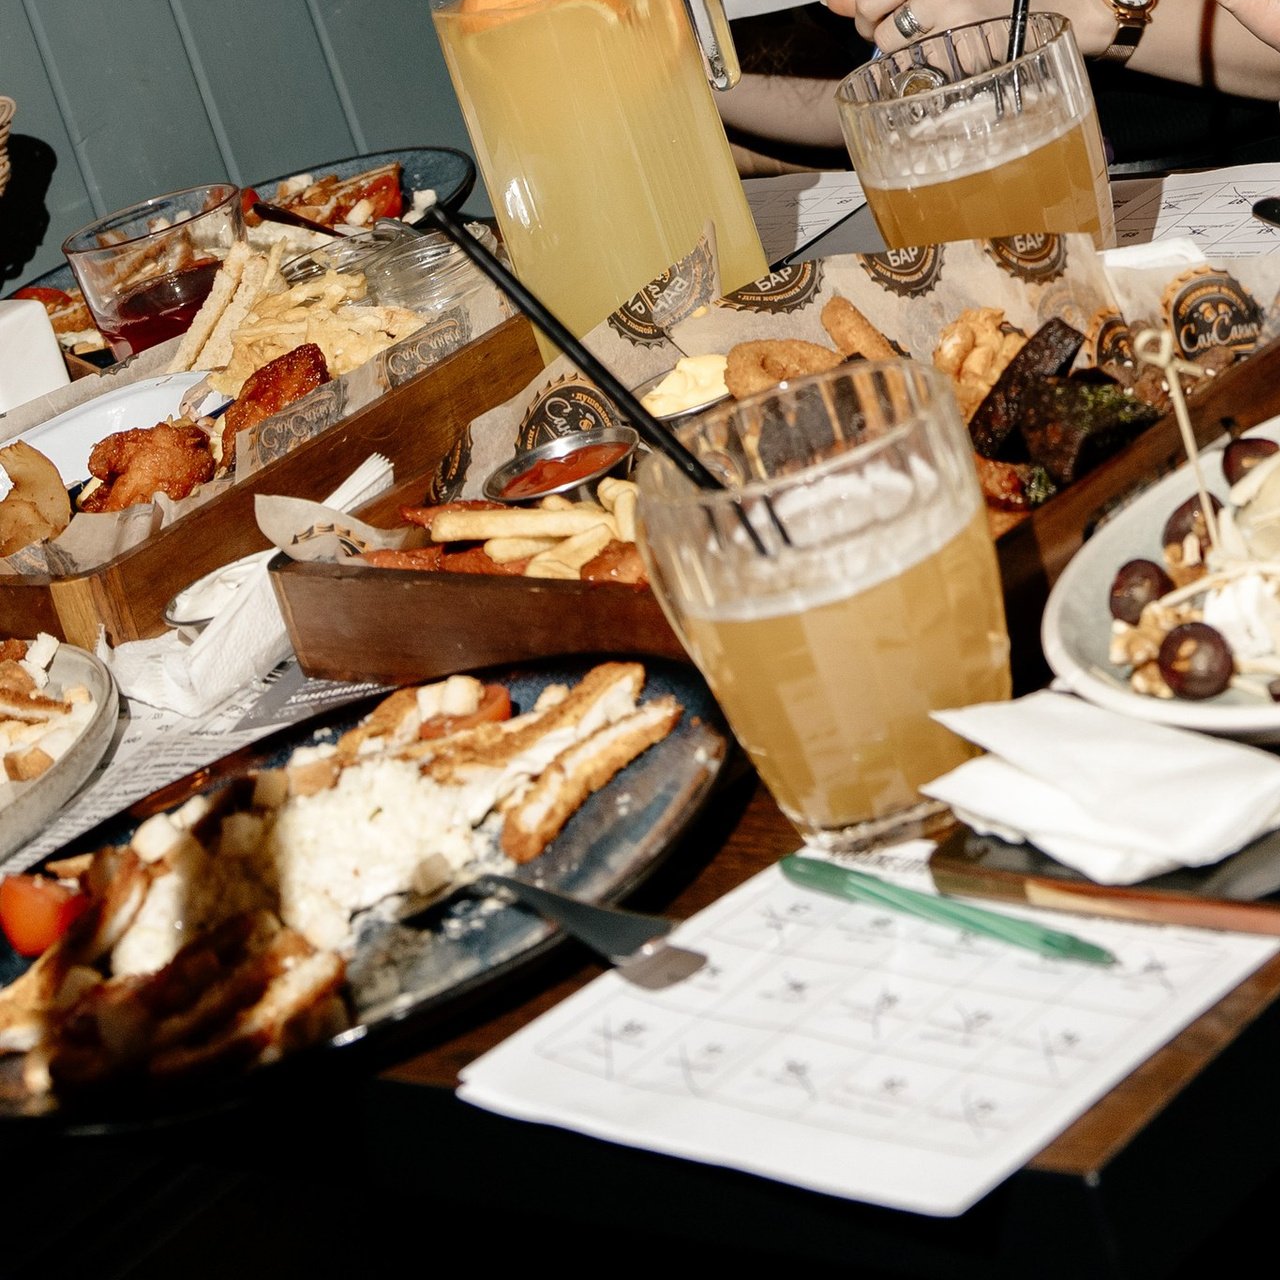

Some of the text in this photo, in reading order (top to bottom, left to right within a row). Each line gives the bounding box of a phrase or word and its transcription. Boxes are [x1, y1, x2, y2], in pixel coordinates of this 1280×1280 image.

[1013, 232, 1045, 254] БАР
[886, 245, 919, 268] БАР
[754, 266, 793, 292] БАР
[762, 286, 801, 302] хороших
[627, 319, 653, 335] людей
